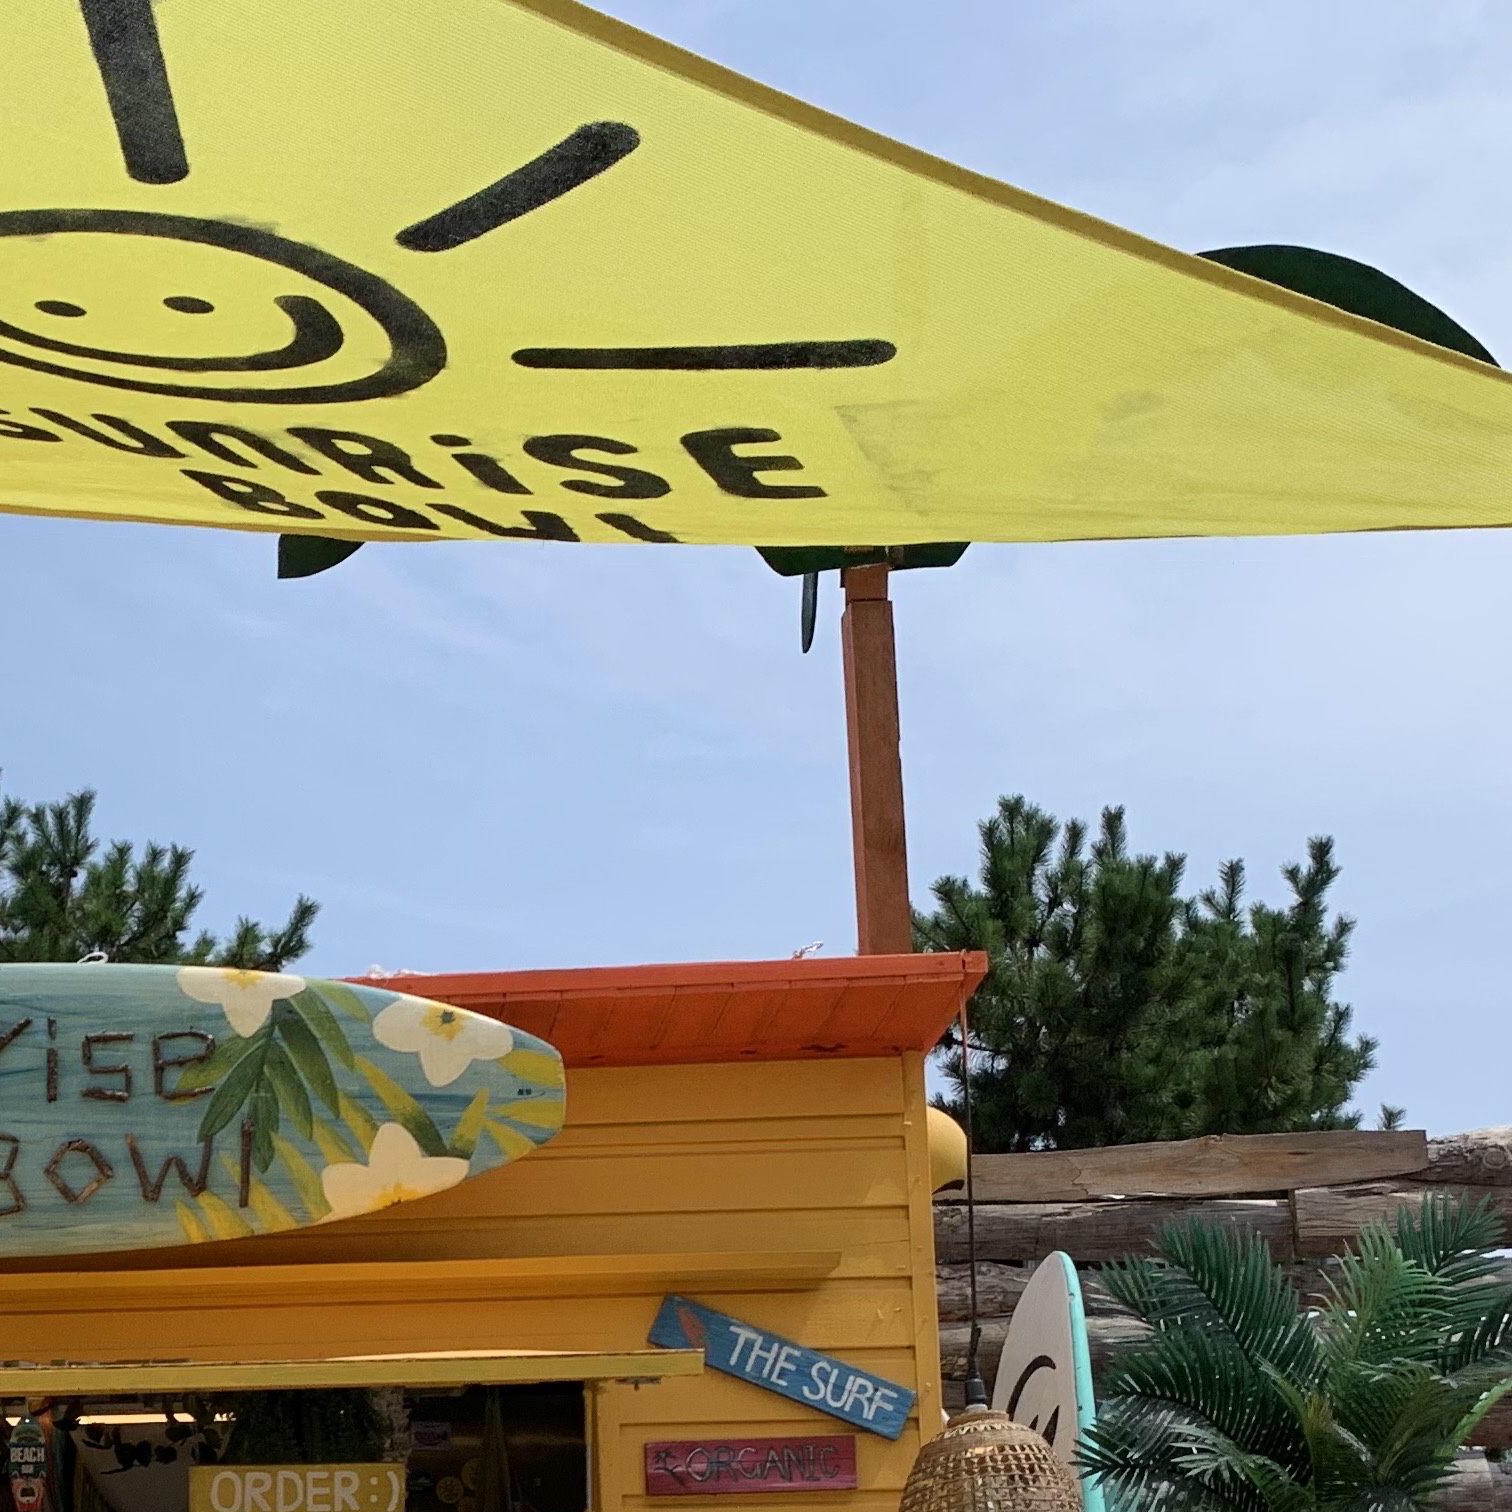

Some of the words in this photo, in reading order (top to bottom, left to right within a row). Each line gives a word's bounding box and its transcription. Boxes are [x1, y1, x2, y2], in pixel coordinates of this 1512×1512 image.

[729, 1325, 801, 1387] THE
[802, 1360, 898, 1421] SURF
[10, 1447, 46, 1462] BEACH
[685, 1445, 840, 1482] ORGANIC
